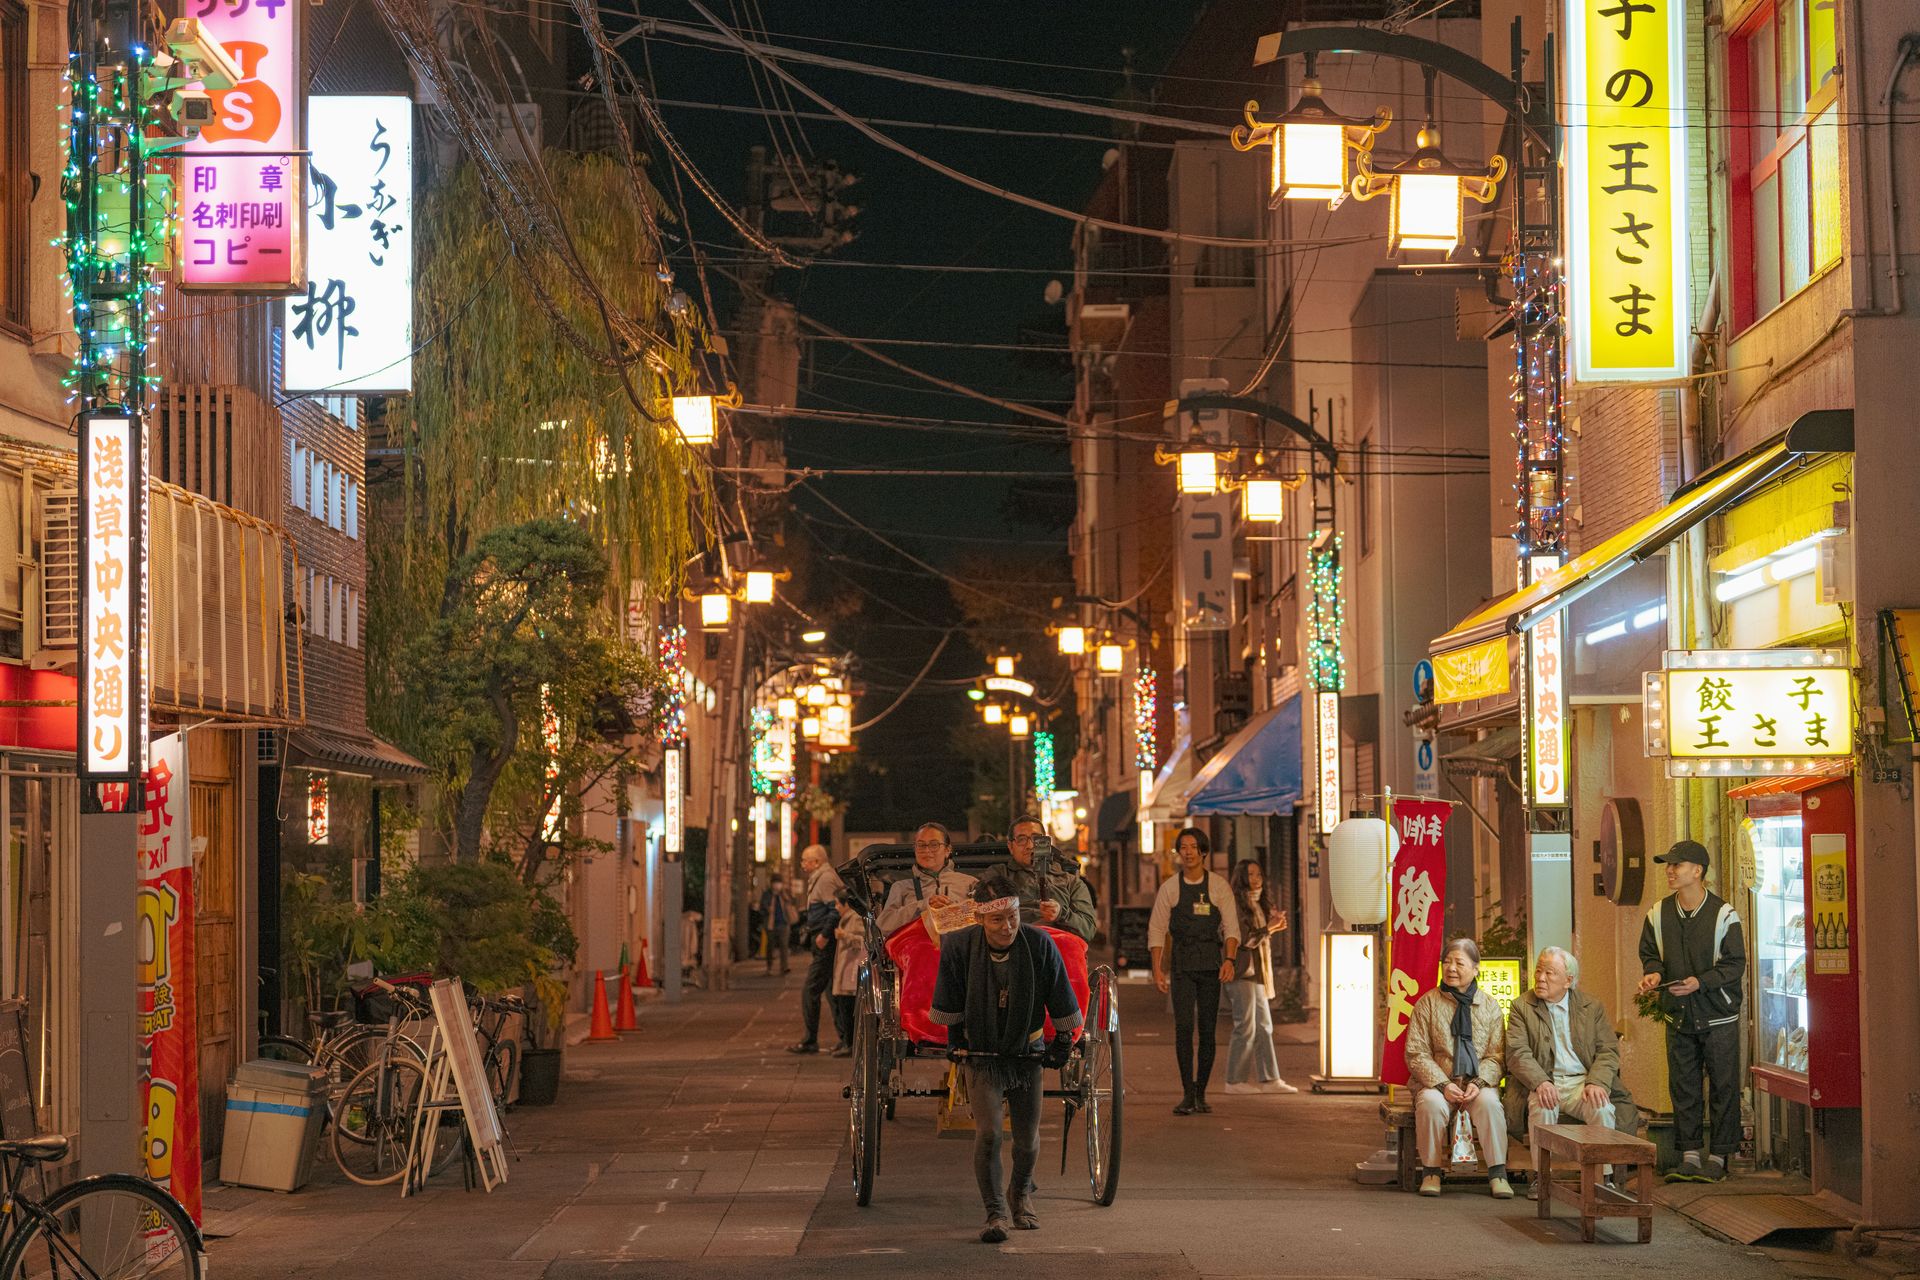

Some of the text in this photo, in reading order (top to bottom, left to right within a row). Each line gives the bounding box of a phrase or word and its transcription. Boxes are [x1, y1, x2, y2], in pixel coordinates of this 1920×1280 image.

[194, 165, 283, 193] 印章
[366, 118, 402, 266] うなぎ
[192, 201, 283, 229] 名刺印刷
[193, 236, 282, 266] コピー
[93, 434, 124, 761] 浅草中央通り
[1696, 676, 1824, 712] 餃子
[1692, 712, 1829, 750] 王さま
[1491, 985, 1513, 996] 540
